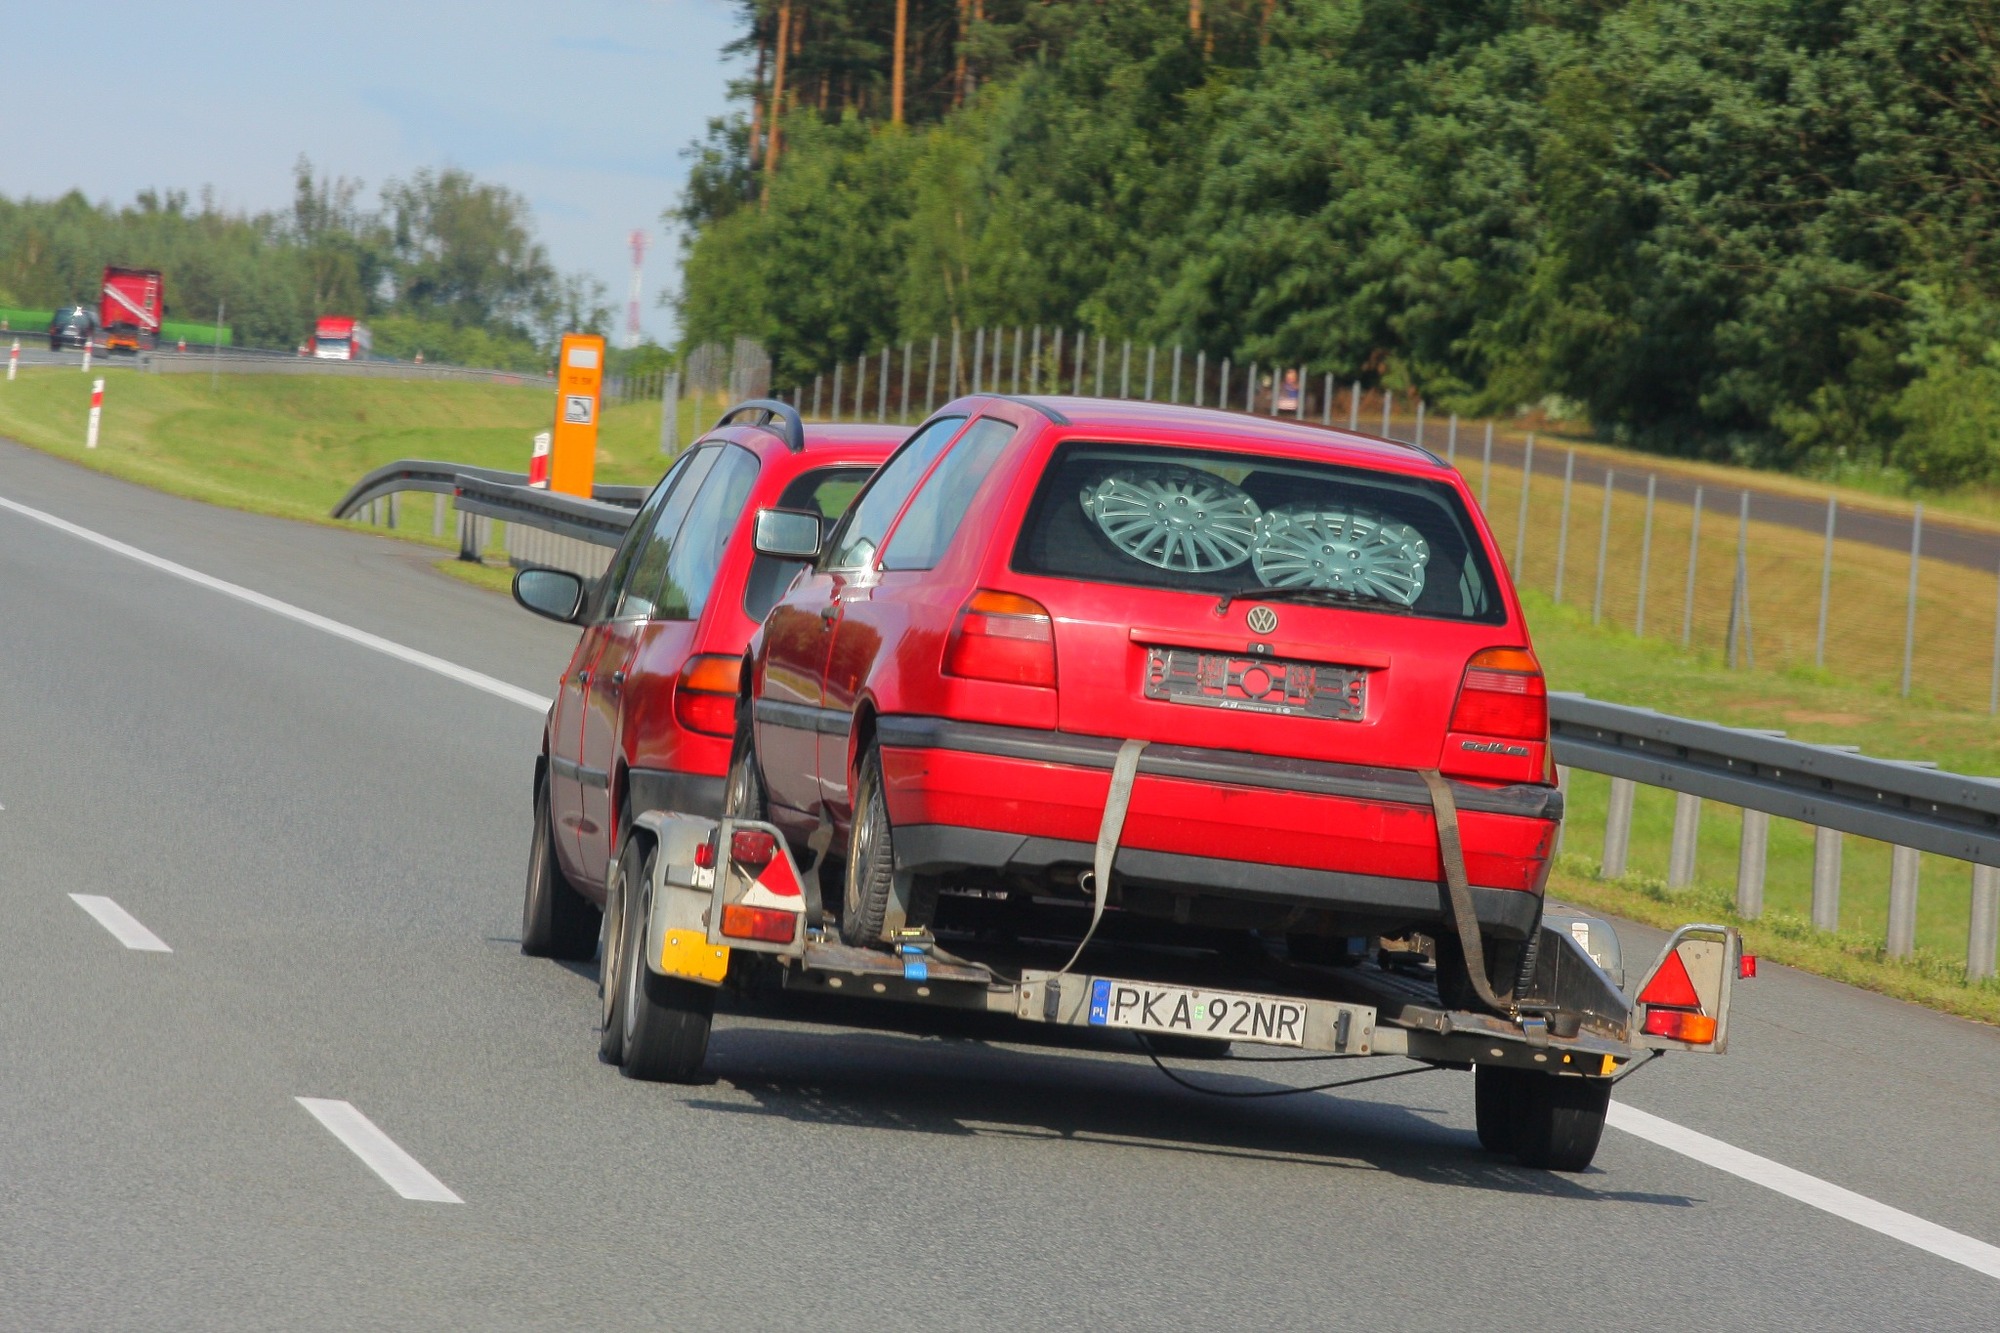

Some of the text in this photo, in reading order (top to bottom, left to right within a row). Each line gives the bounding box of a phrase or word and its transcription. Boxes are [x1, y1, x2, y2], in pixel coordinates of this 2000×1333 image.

[1092, 1006, 1105, 1018] PL
[1113, 987, 1301, 1041] PKA 92NR
